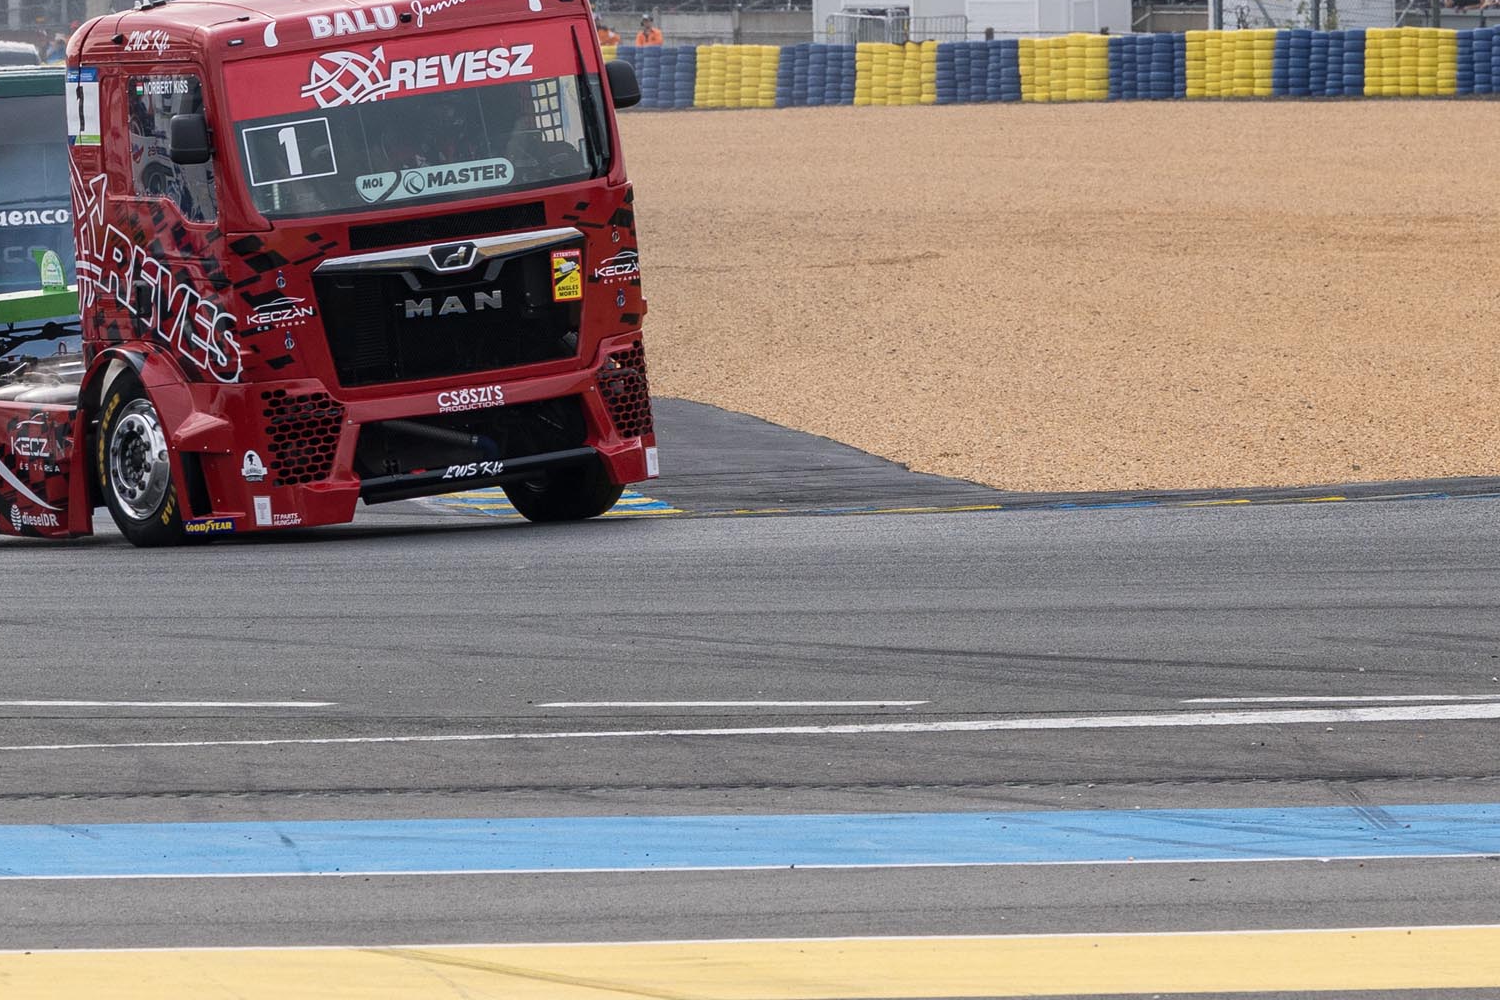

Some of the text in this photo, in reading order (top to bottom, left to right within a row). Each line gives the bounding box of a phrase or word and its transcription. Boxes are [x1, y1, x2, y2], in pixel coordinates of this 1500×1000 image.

[308, 4, 398, 40] BALU
[388, 43, 534, 92] REVESZ
[143, 80, 189, 95] NORBERT KISS
[278, 127, 304, 176] 1
[362, 177, 384, 190] MOL
[427, 163, 508, 188] MASTER
[405, 289, 503, 319] MAN
[439, 399, 505, 414] PRODUCTIONS
[22, 511, 60, 528] dieselDR
[186, 519, 233, 533] GOODYEAR
